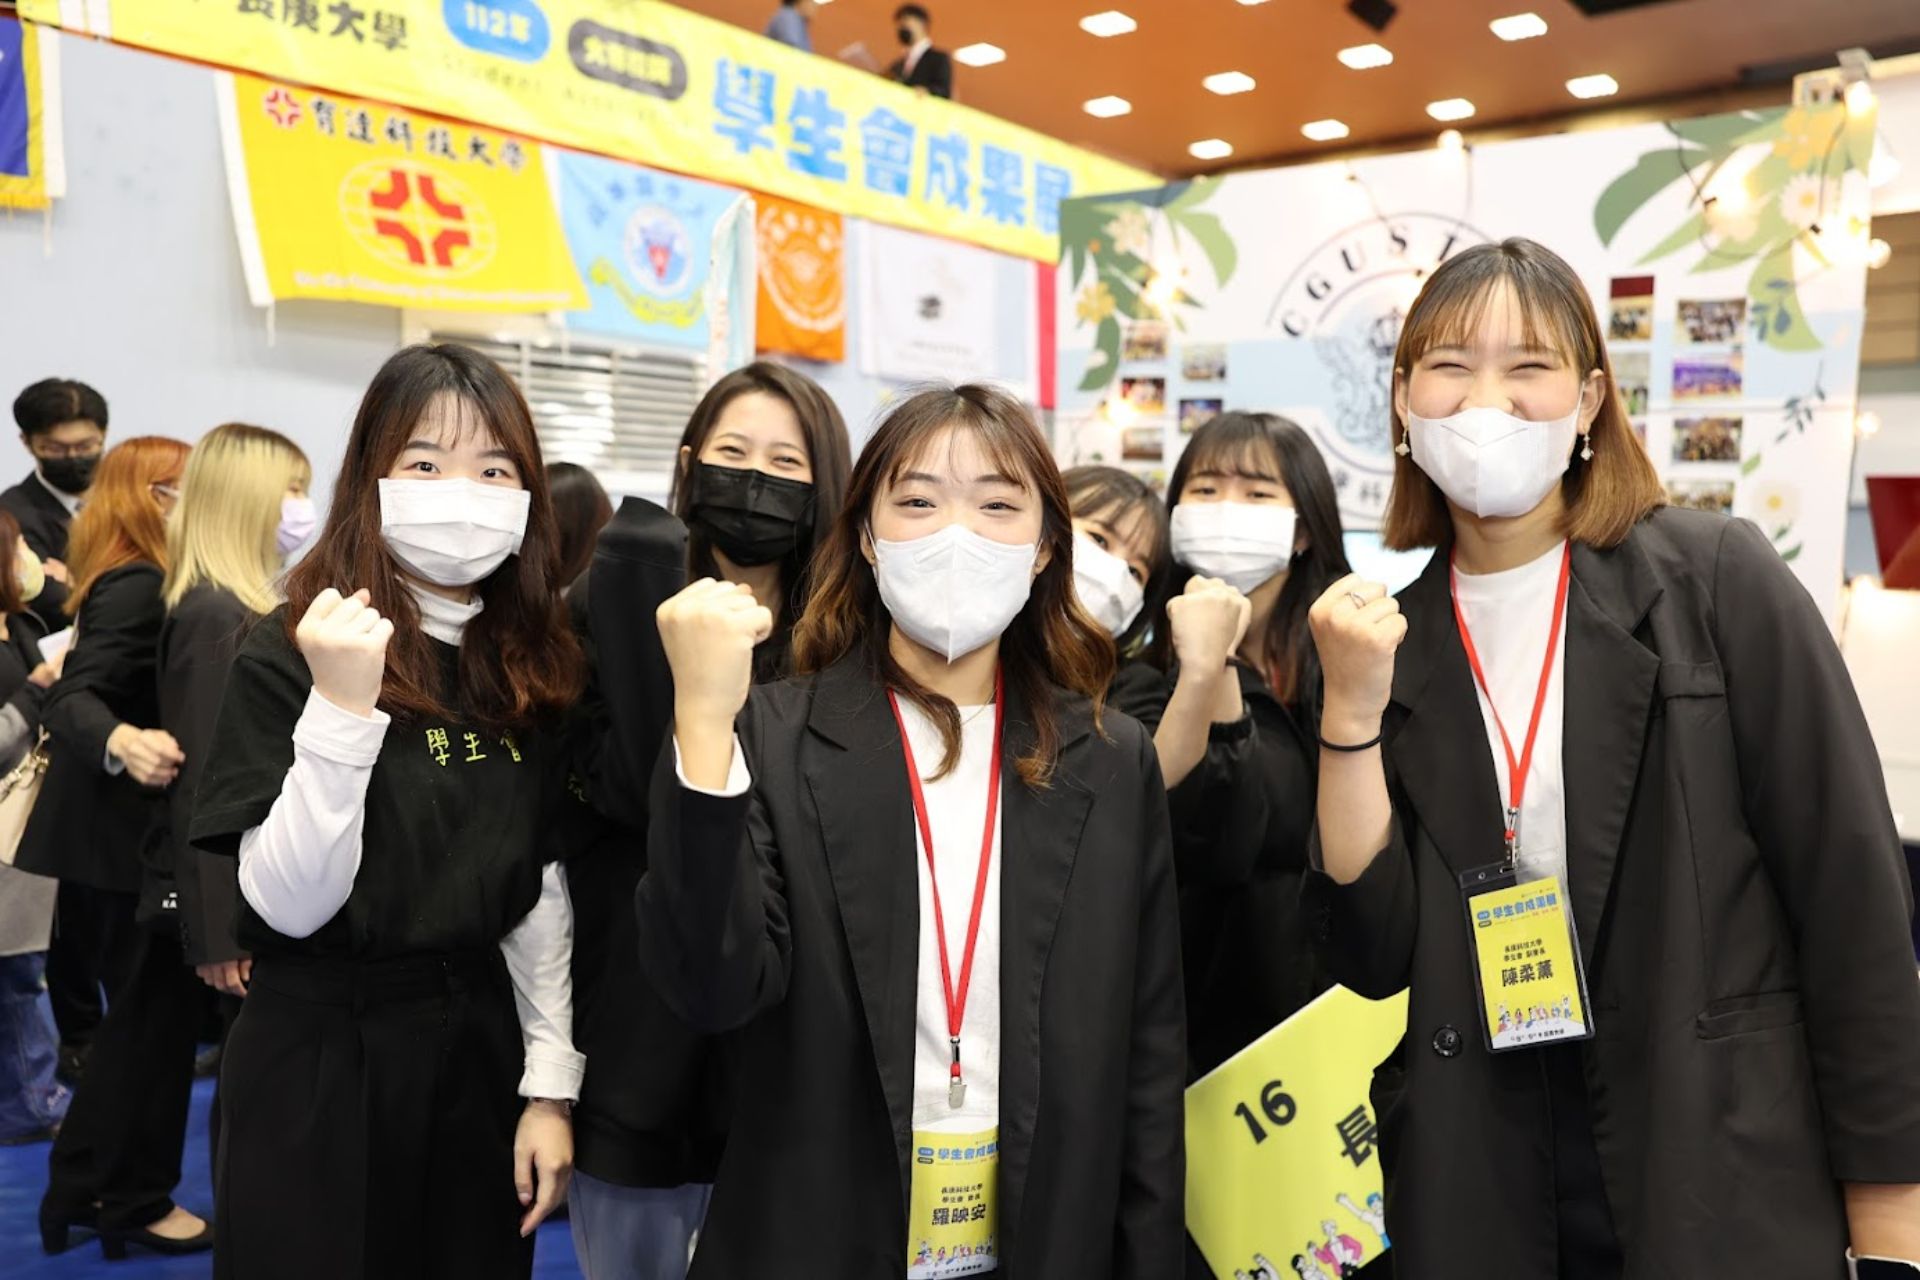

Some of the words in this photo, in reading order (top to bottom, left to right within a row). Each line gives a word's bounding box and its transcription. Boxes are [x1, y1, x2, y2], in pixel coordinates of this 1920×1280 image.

[712, 57, 1071, 236] 學生會成果展
[1233, 1079, 1297, 1146] 16
[937, 1142, 999, 1161] 學生會成果
